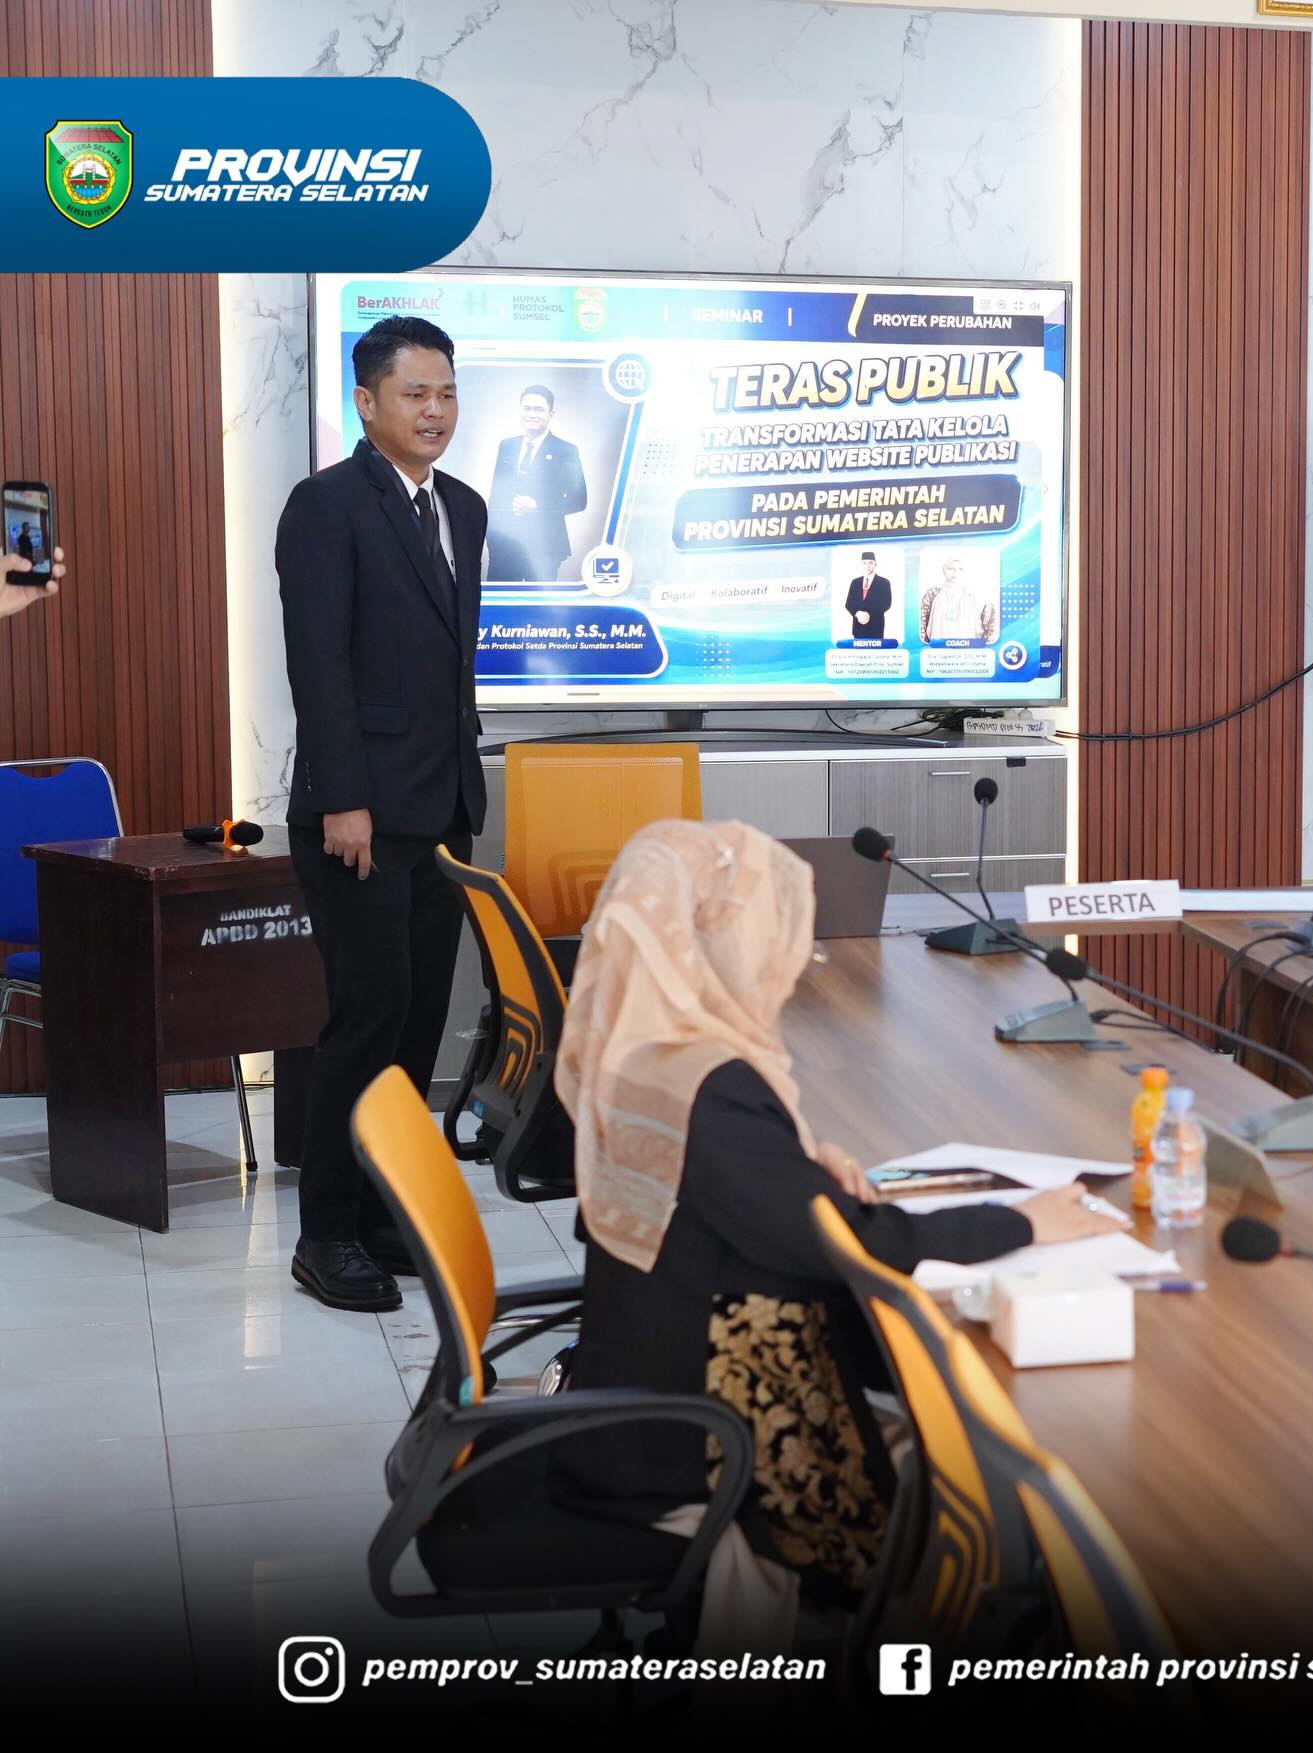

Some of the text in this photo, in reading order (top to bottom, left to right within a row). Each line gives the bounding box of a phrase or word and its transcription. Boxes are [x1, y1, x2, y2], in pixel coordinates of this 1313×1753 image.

[357, 295, 440, 310] BerAKHLAK
[512, 296, 547, 304] HUMAS
[512, 304, 564, 313] PROTOKOL
[513, 313, 550, 321] SUMSEL
[692, 307, 763, 324] SEMINAR
[873, 313, 1012, 330] PROYEK PERUBAHAN
[709, 351, 1021, 411] TERAS PUBLIK
[701, 414, 1009, 450] TRANSFORMASI TATA KELOLA
[695, 440, 1018, 476] PENERAPAN WEBSITE PUBLIKASI
[751, 484, 946, 513] PADA PEMERINTAH
[683, 504, 1005, 542] PROVINSI SUMATERA SELATAN
[661, 582, 818, 602] Digital Kolaboratif Inovatif
[491, 624, 571, 640] Kurniawan,
[574, 624, 607, 640] S.S.,
[610, 624, 647, 638] M.M.
[491, 642, 524, 650] Protokol
[548, 642, 578, 650] Provinsi
[579, 642, 615, 650] Sumatera
[615, 641, 644, 650] Selatan
[853, 640, 882, 648] MENTOR
[945, 640, 970, 648] COACH
[1049, 892, 1156, 917] PESERTA
[201, 916, 313, 946] APBD 2013
